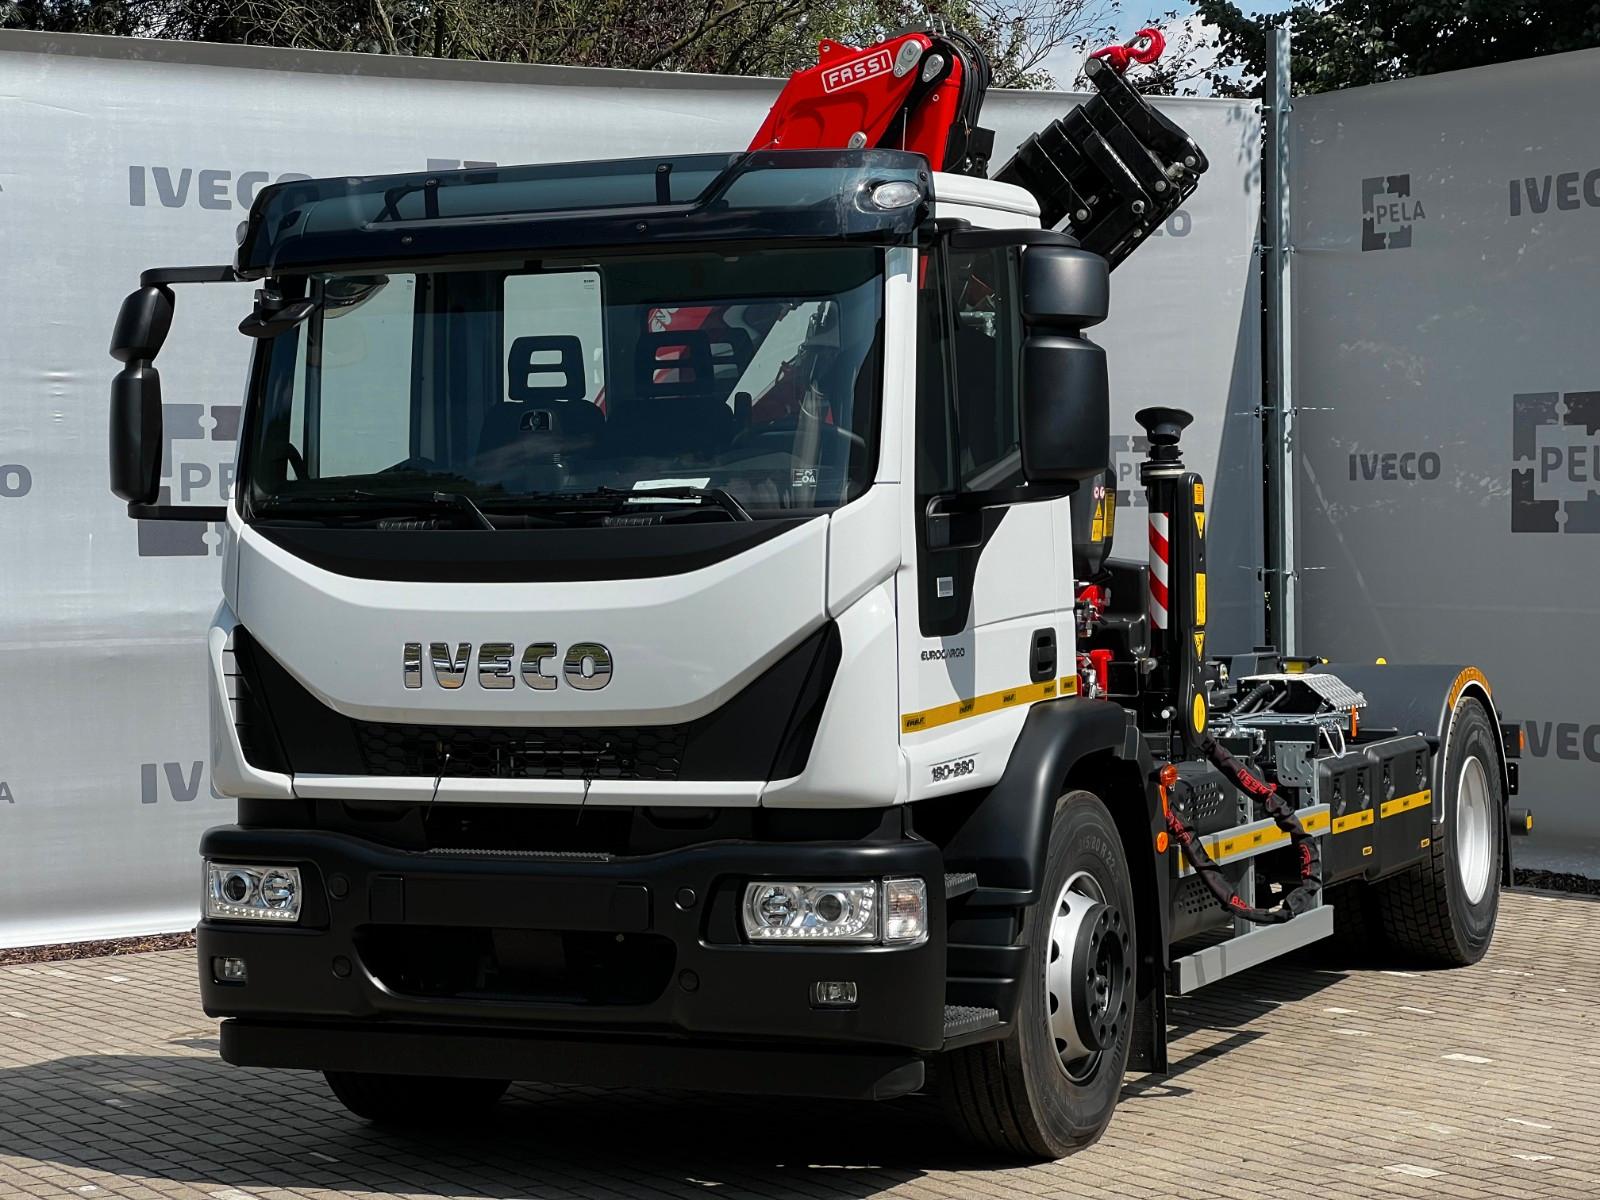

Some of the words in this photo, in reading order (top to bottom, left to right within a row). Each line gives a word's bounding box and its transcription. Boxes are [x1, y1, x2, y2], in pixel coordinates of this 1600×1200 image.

[828, 55, 887, 87] FASSI
[129, 166, 314, 210] IVEC
[1376, 200, 1426, 225] PELA
[1349, 451, 1441, 481] IVECO
[403, 642, 613, 690] IVECO
[920, 647, 966, 661] EUROCARGO
